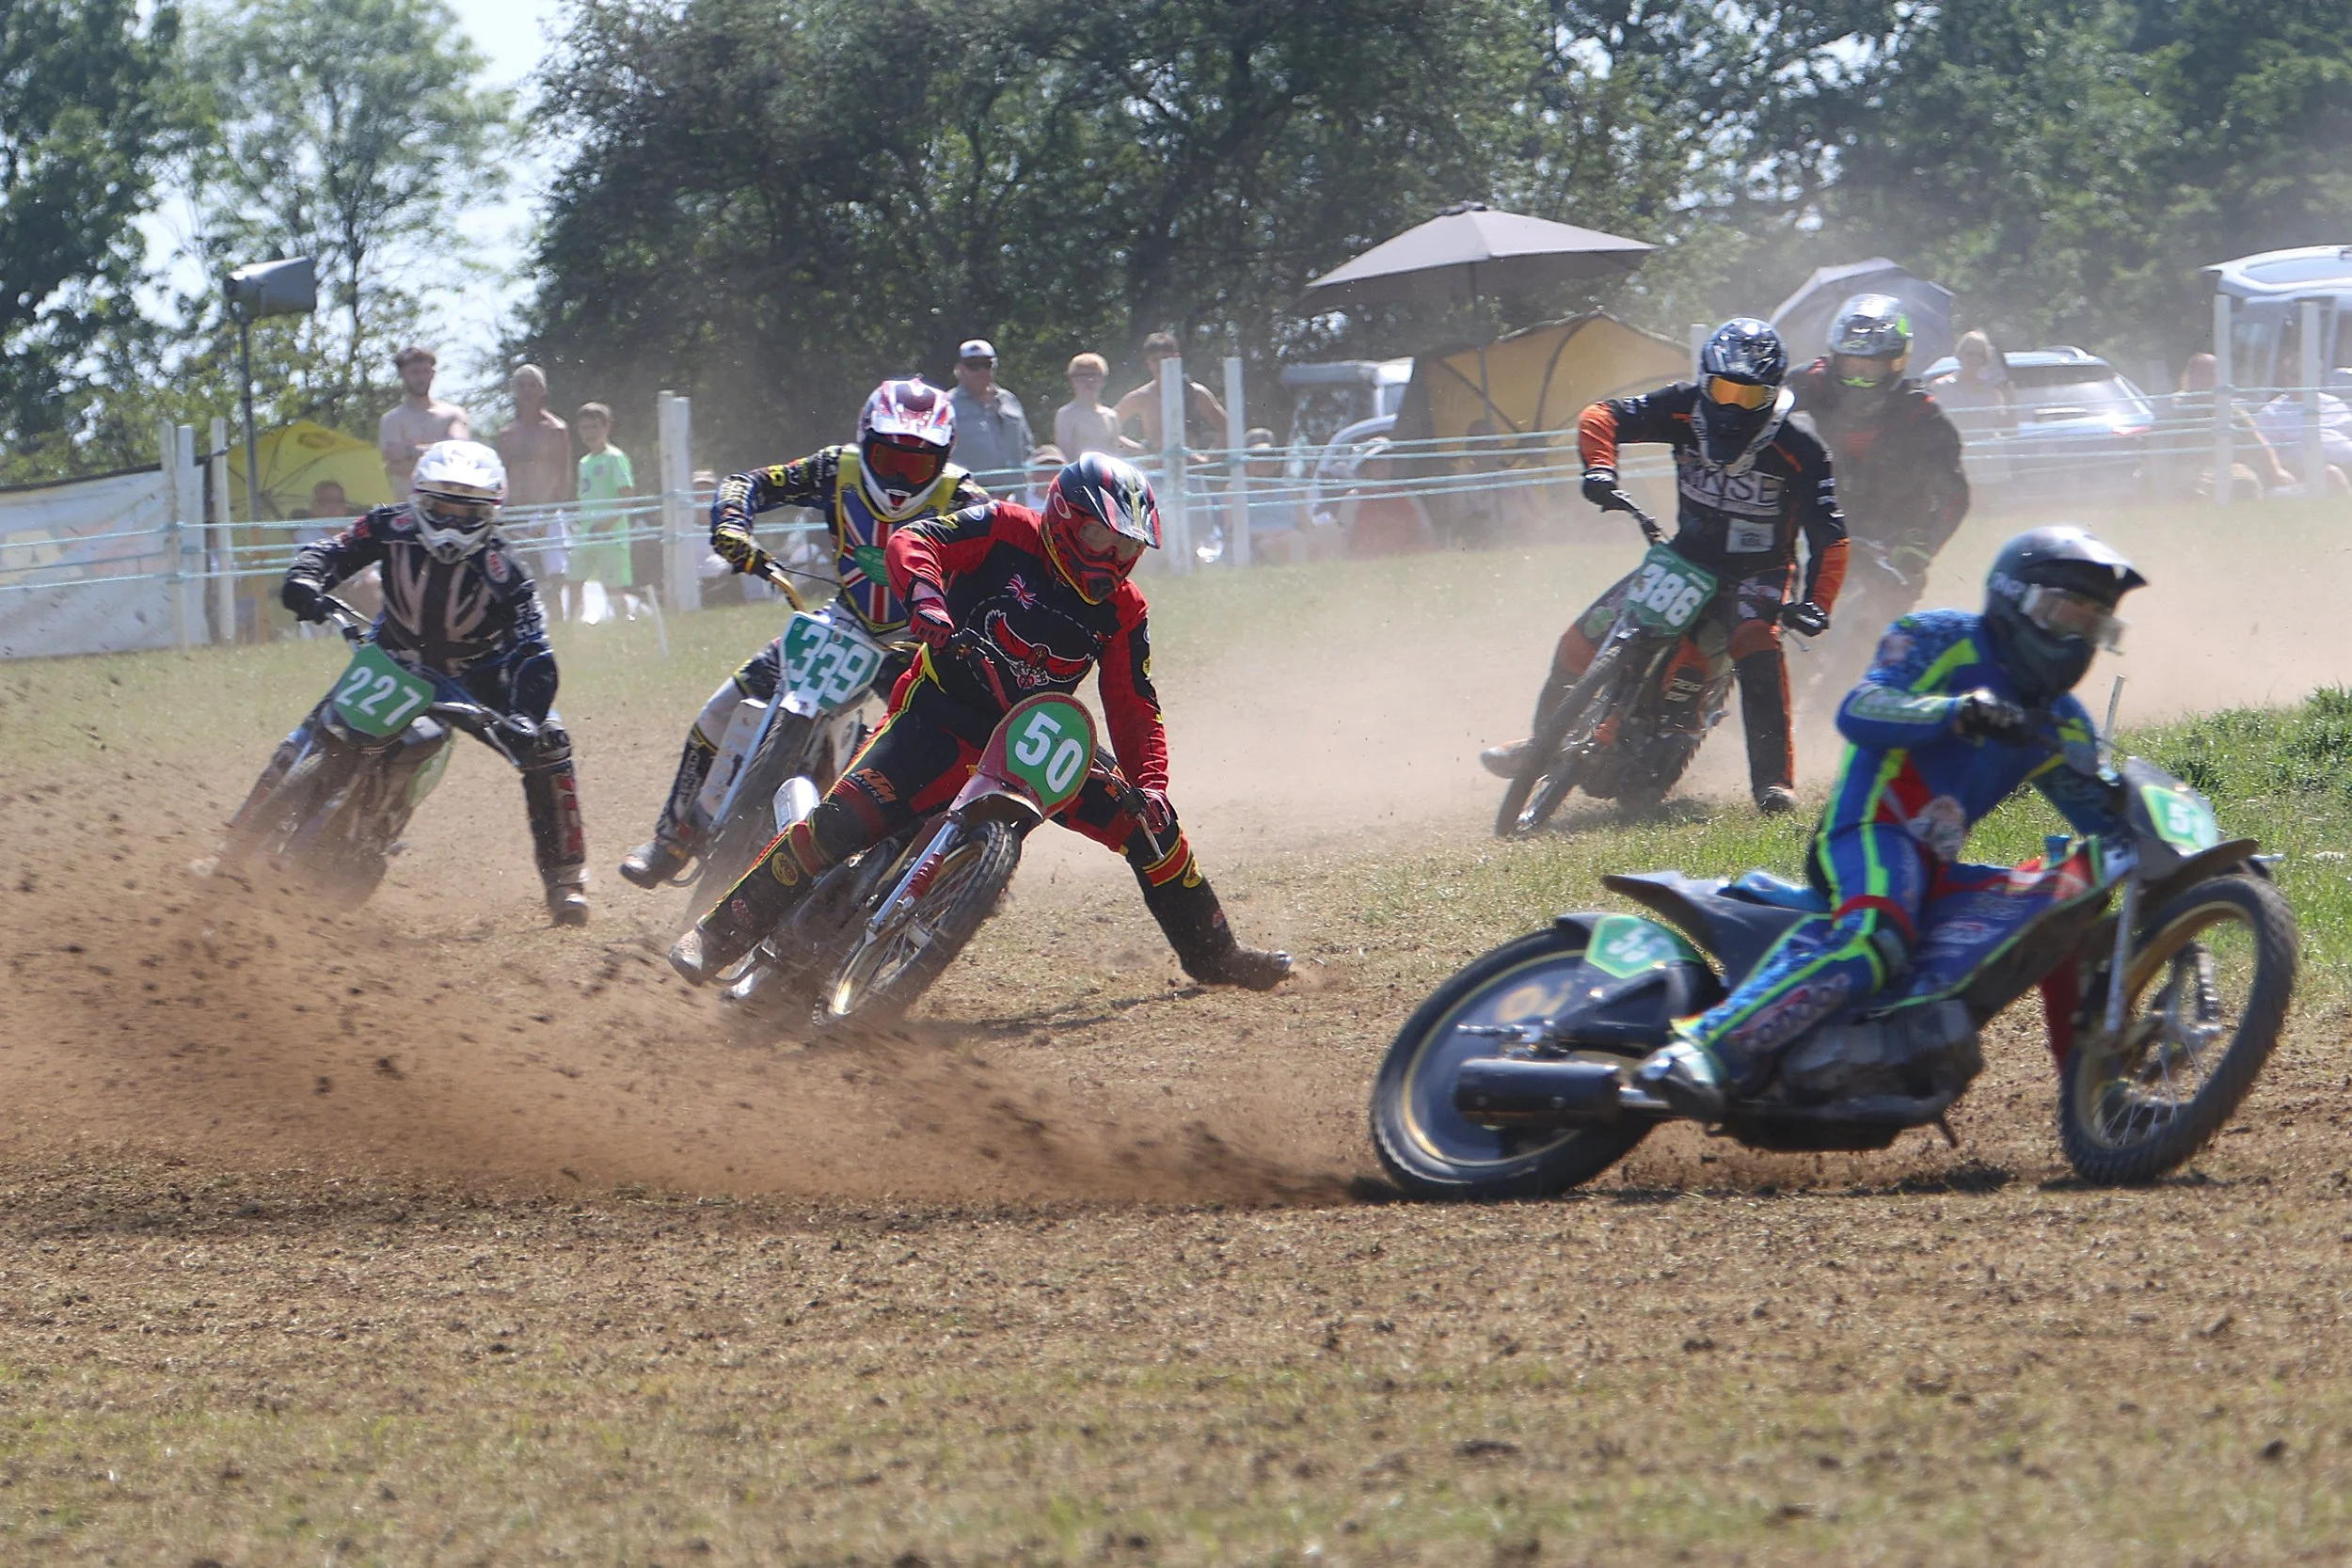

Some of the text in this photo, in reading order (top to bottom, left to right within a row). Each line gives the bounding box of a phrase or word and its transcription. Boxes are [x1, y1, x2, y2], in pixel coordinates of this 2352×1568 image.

[1628, 562, 1704, 626] 386
[334, 666, 423, 726] 227
[787, 624, 875, 704] 339
[1014, 711, 1083, 793] 50
[854, 768, 898, 802] KTM
